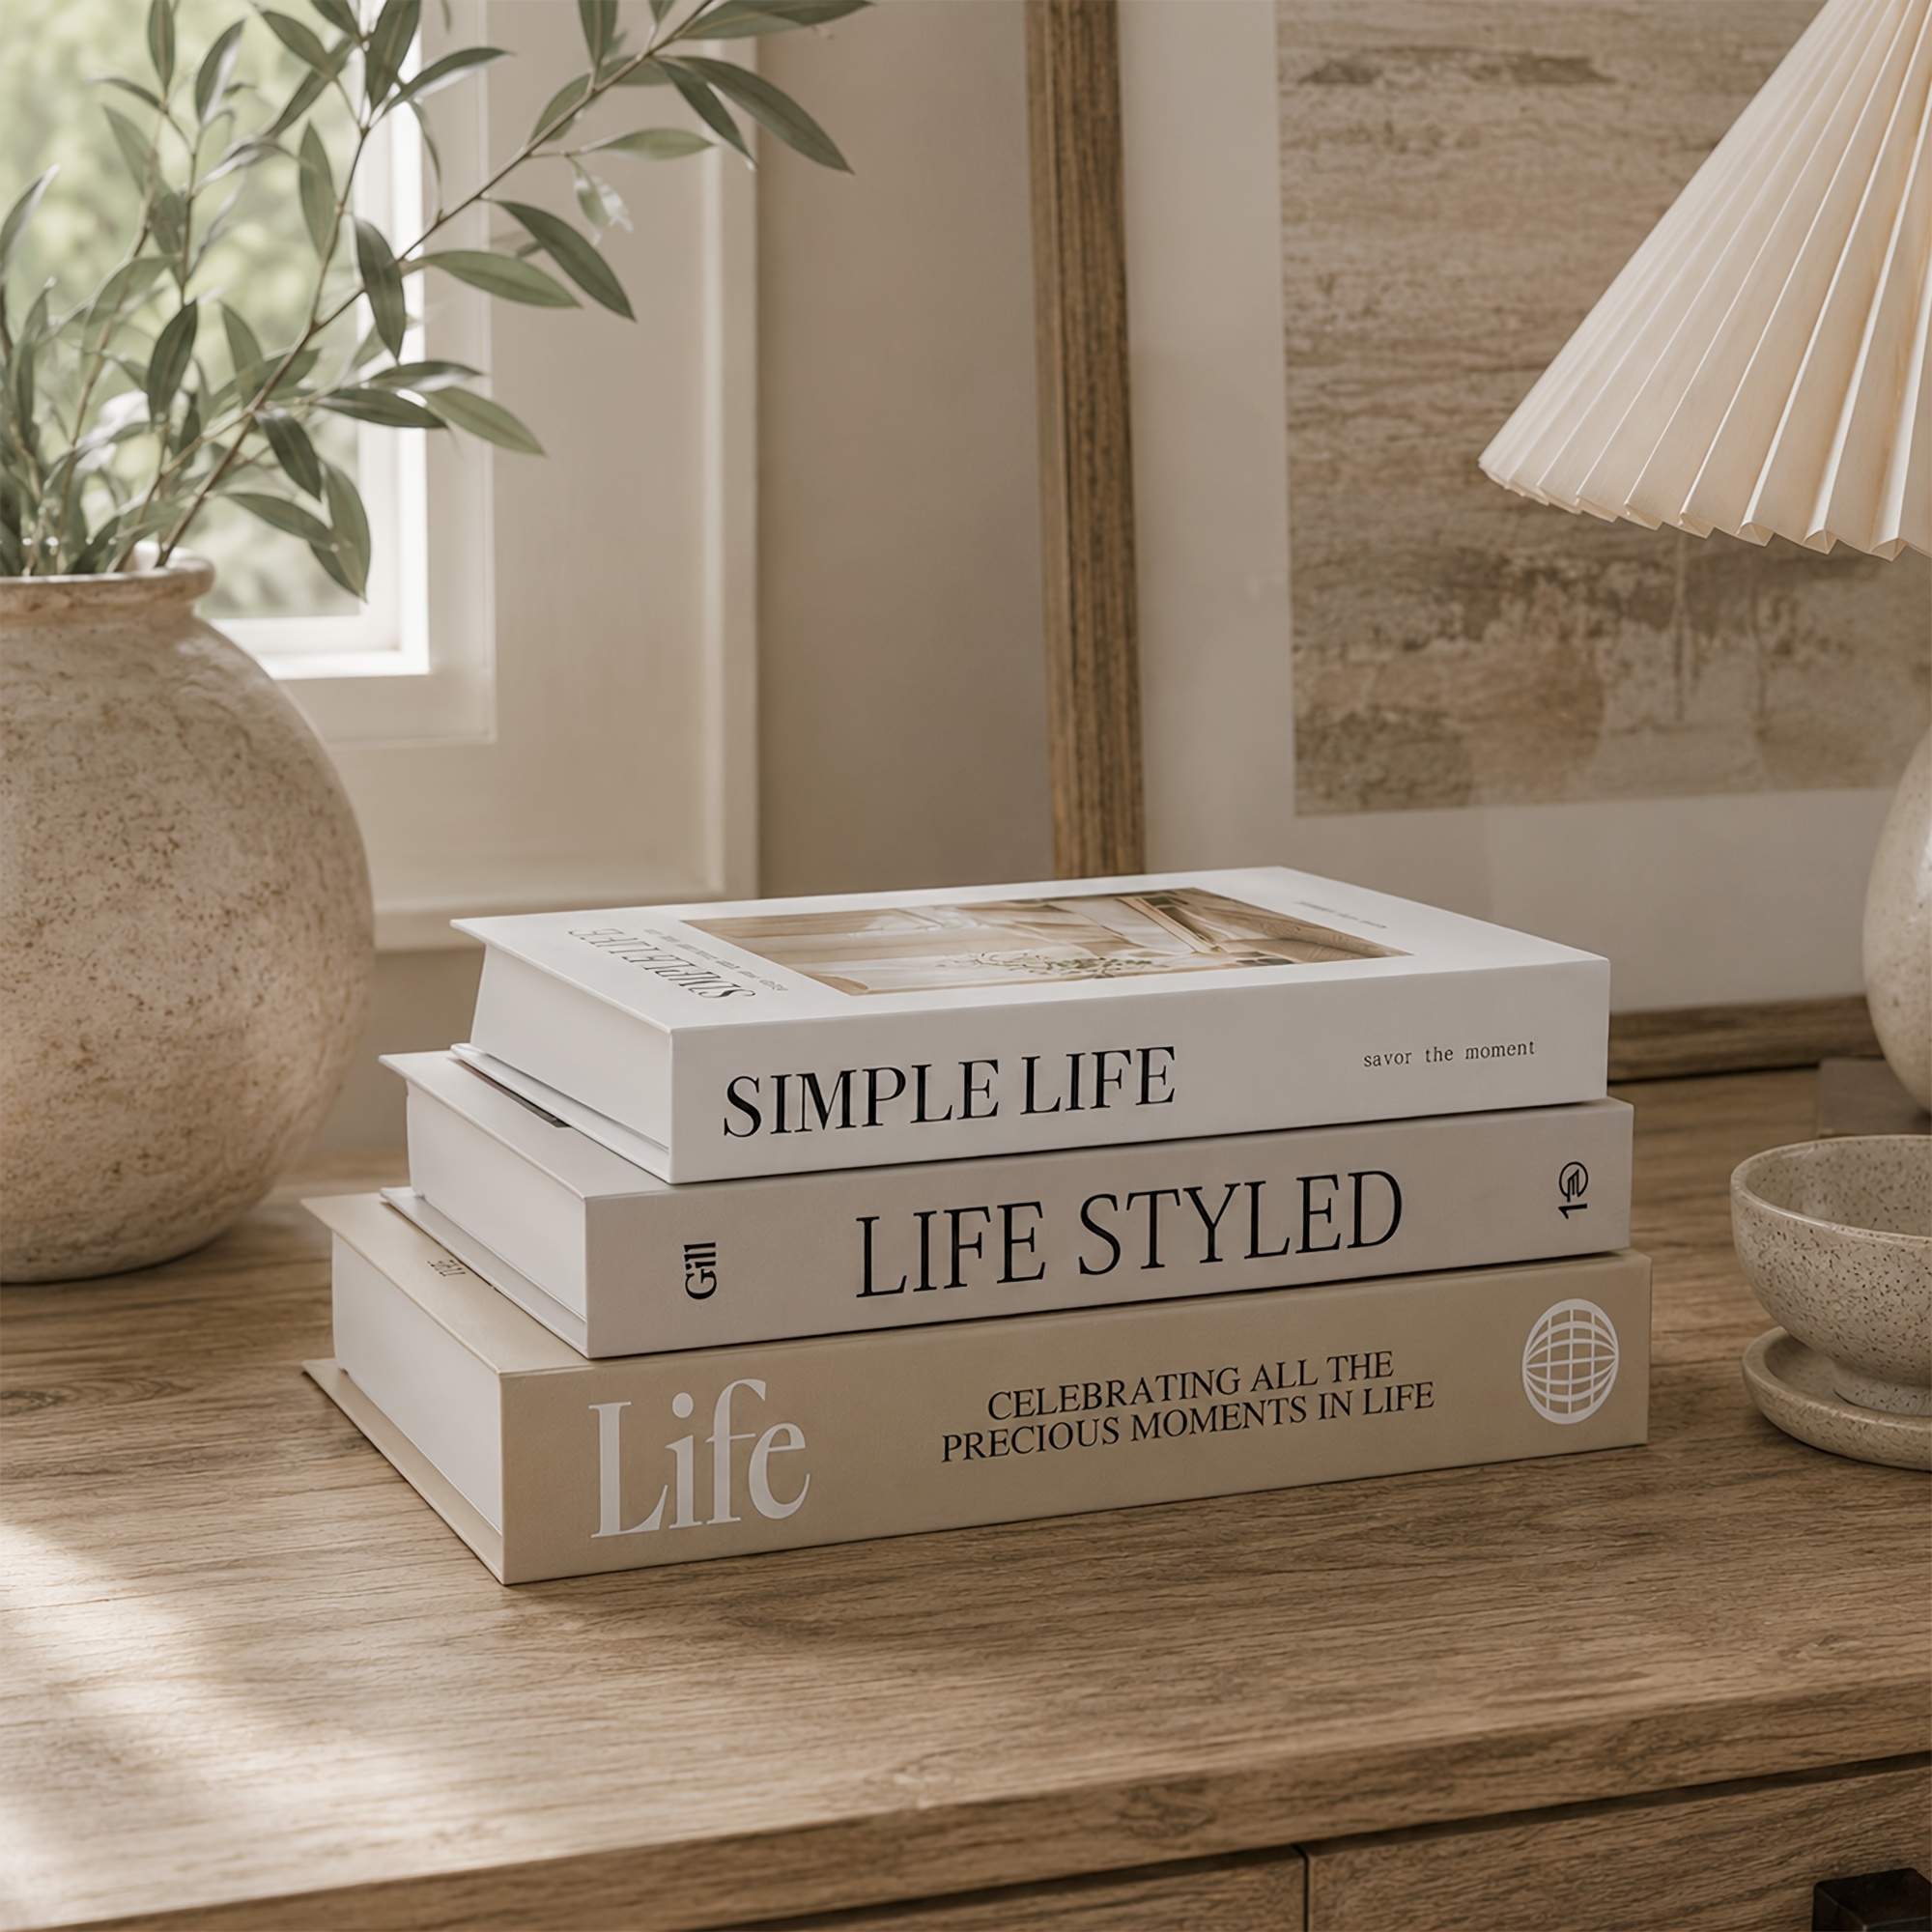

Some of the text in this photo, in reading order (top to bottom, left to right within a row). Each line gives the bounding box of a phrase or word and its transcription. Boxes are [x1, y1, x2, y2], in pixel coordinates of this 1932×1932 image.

[724, 1045, 1176, 1138] SIMPLE LIFE
[1363, 1040, 1535, 1067] savor the moment
[683, 1241, 717, 1301] Gill
[856, 1170, 1403, 1298] LIFE STYLED
[941, 1380, 1435, 1463] PRECIOUS MOMENTS IN LIFE
[987, 1350, 1395, 1421] CELEBRATING ALL THE
[588, 1378, 810, 1539] Life
